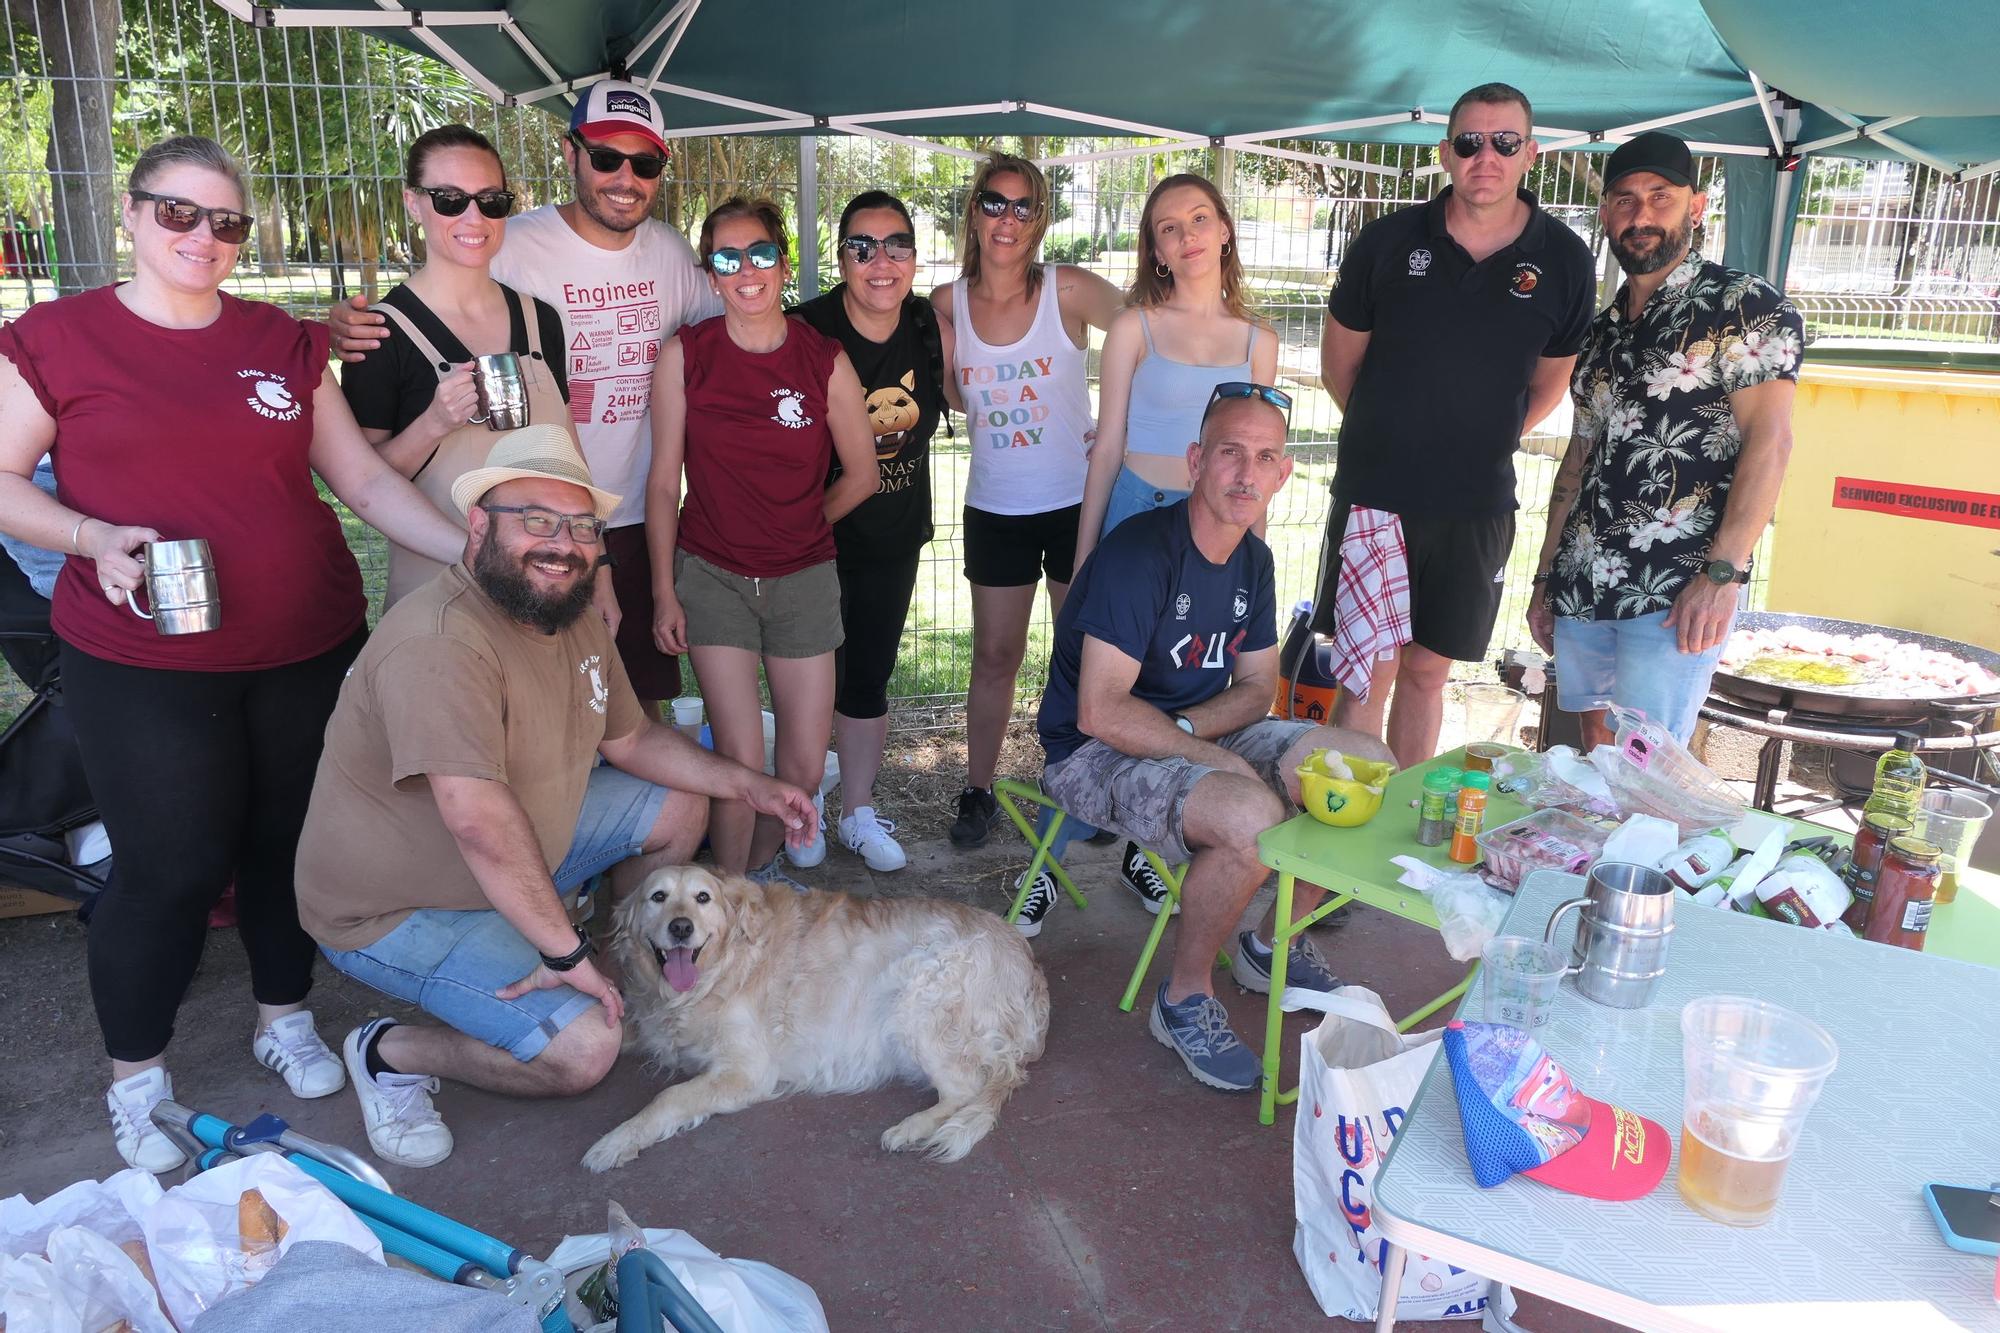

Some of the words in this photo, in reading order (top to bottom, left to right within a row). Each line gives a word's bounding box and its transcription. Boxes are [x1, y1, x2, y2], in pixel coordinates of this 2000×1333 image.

[611, 103, 649, 118] patagonia
[563, 280, 655, 307] Engineer
[589, 329, 614, 337] WARNING
[576, 358, 583, 371] R
[961, 356, 1053, 386] TODAY
[607, 393, 643, 408] 24Hr
[793, 391, 806, 400] XV
[980, 388, 1009, 407] IS
[1019, 384, 1039, 402] A
[976, 405, 1050, 429] GOOD
[990, 427, 1044, 449] DAY
[1840, 486, 1896, 505] SERVICIO
[1900, 494, 1967, 514] EXCLUSIVO
[1970, 502, 1988, 517] DE
[1442, 1295, 1490, 1317] ALD
